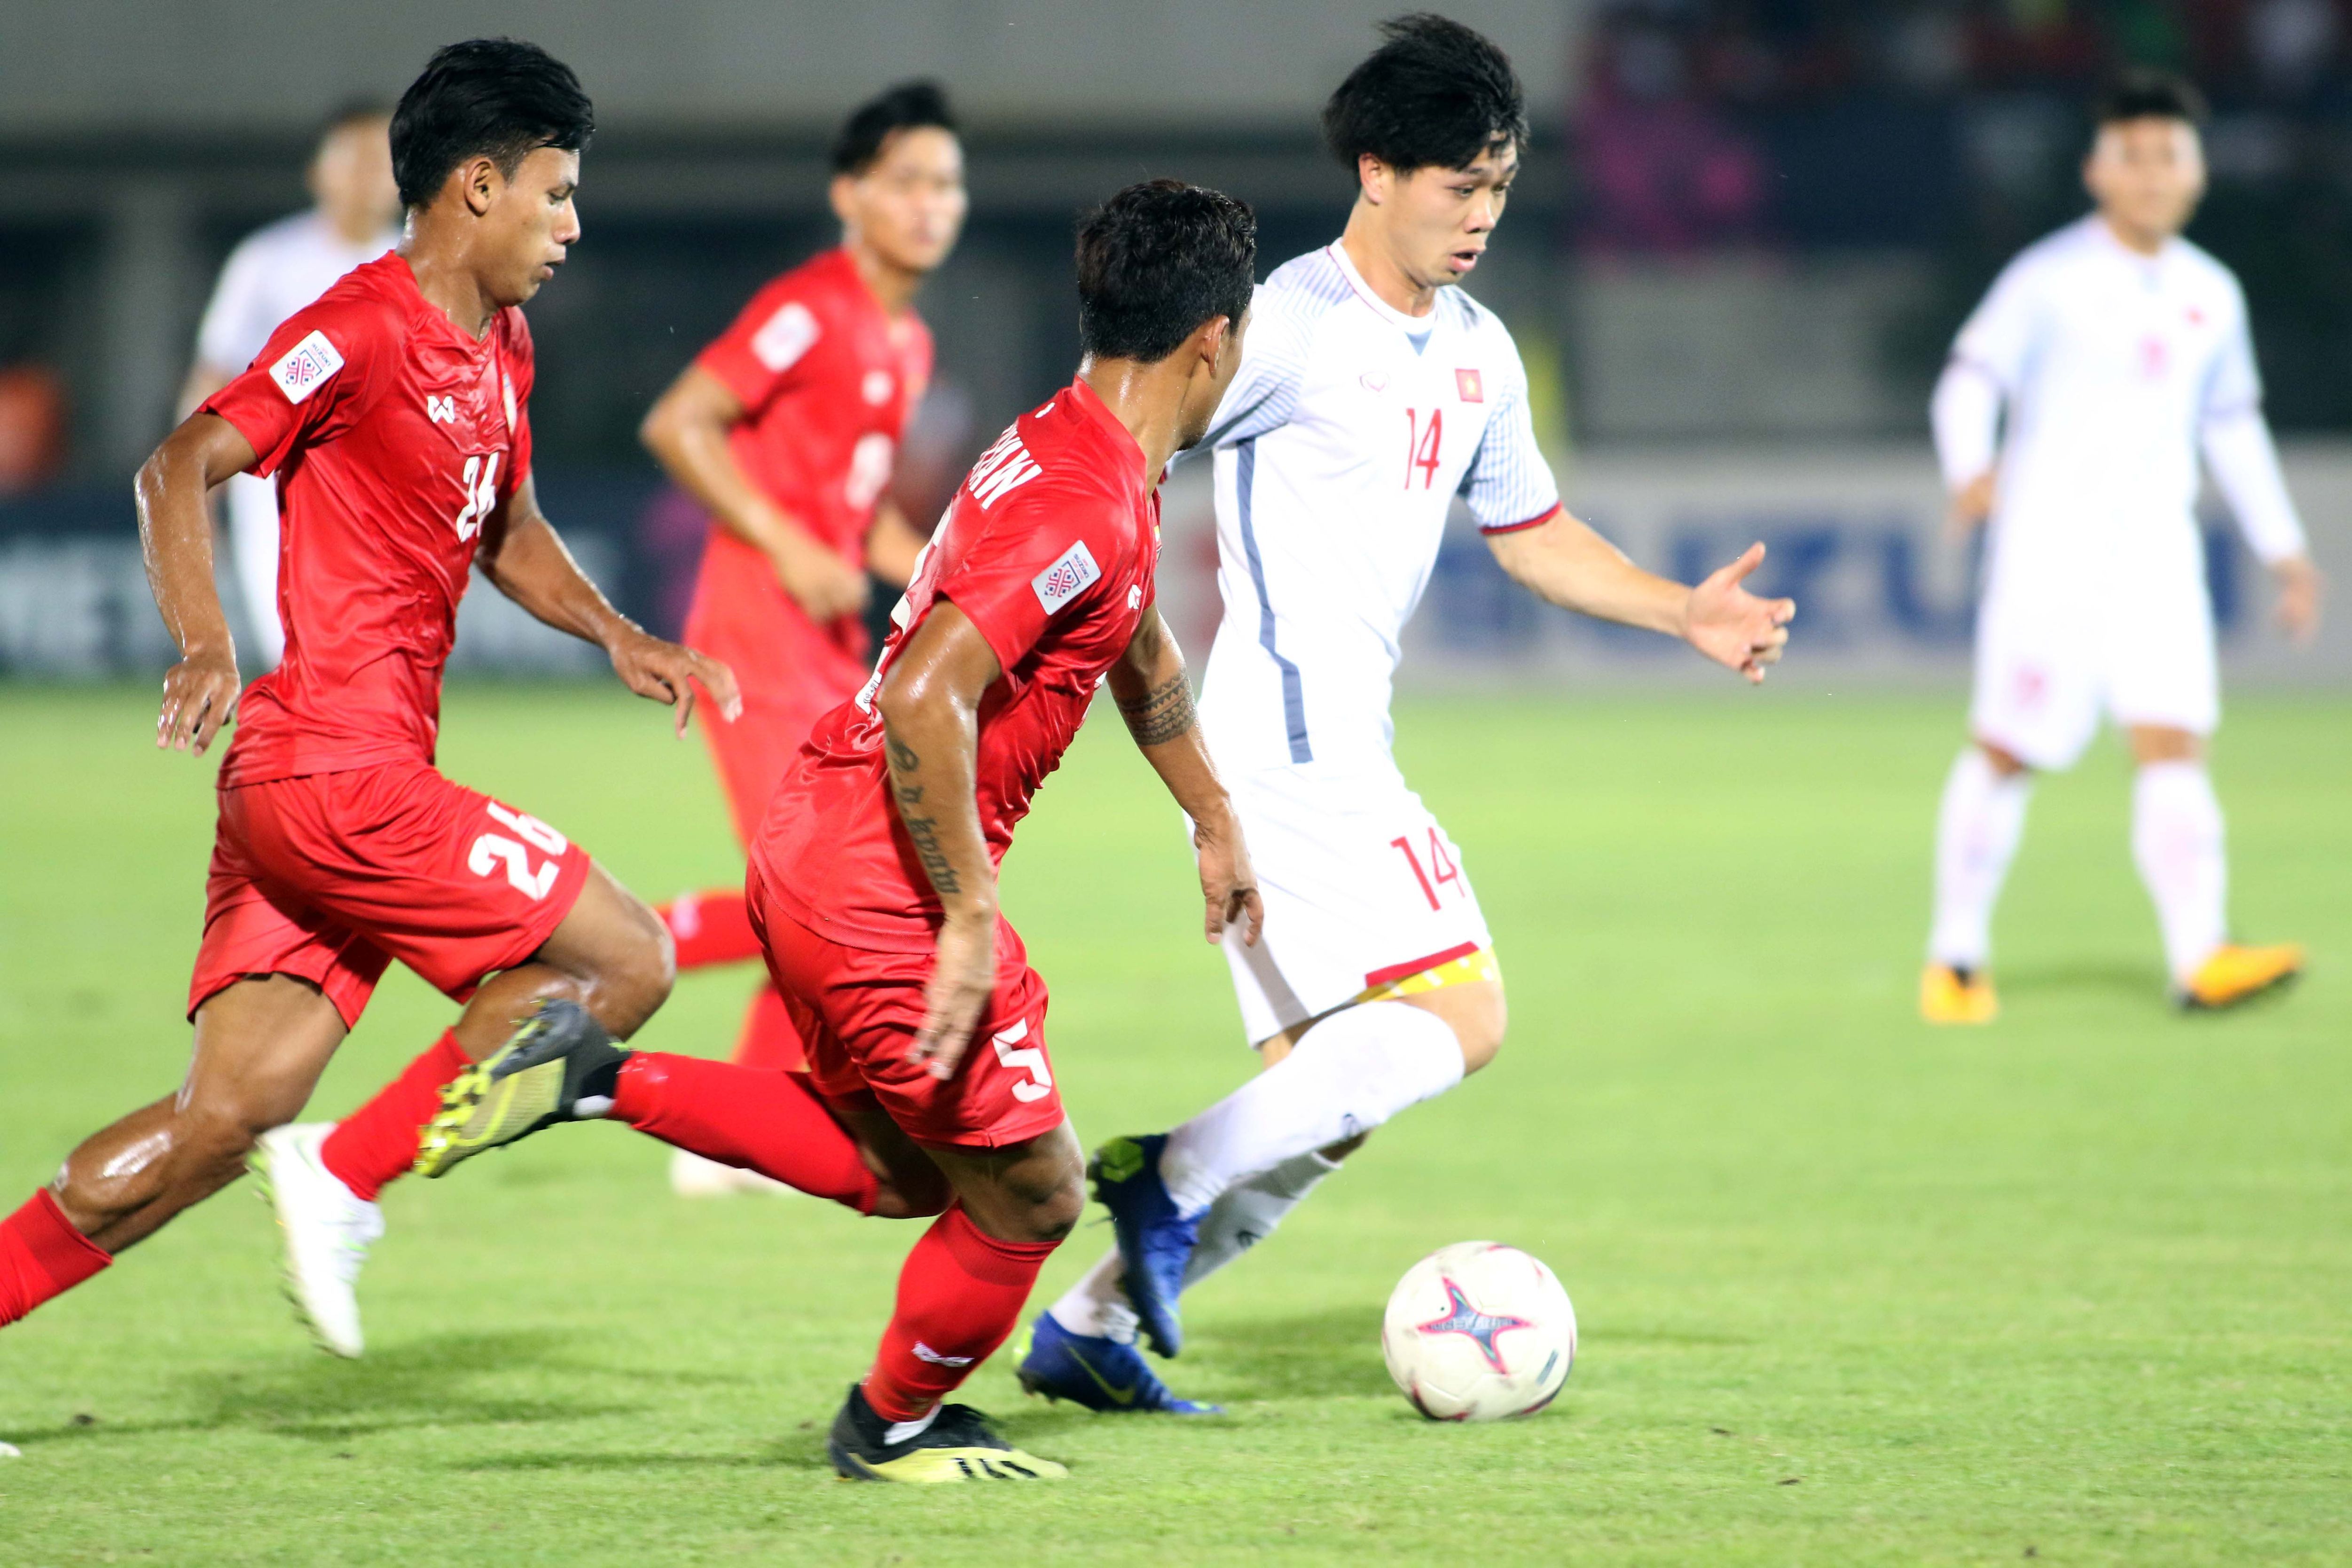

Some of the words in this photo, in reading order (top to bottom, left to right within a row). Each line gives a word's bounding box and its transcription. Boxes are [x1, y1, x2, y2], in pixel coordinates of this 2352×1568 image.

[1404, 408, 1442, 490] 14
[468, 800, 567, 902] 26
[1389, 826, 1465, 912] 14
[992, 1017, 1052, 1103] 5
